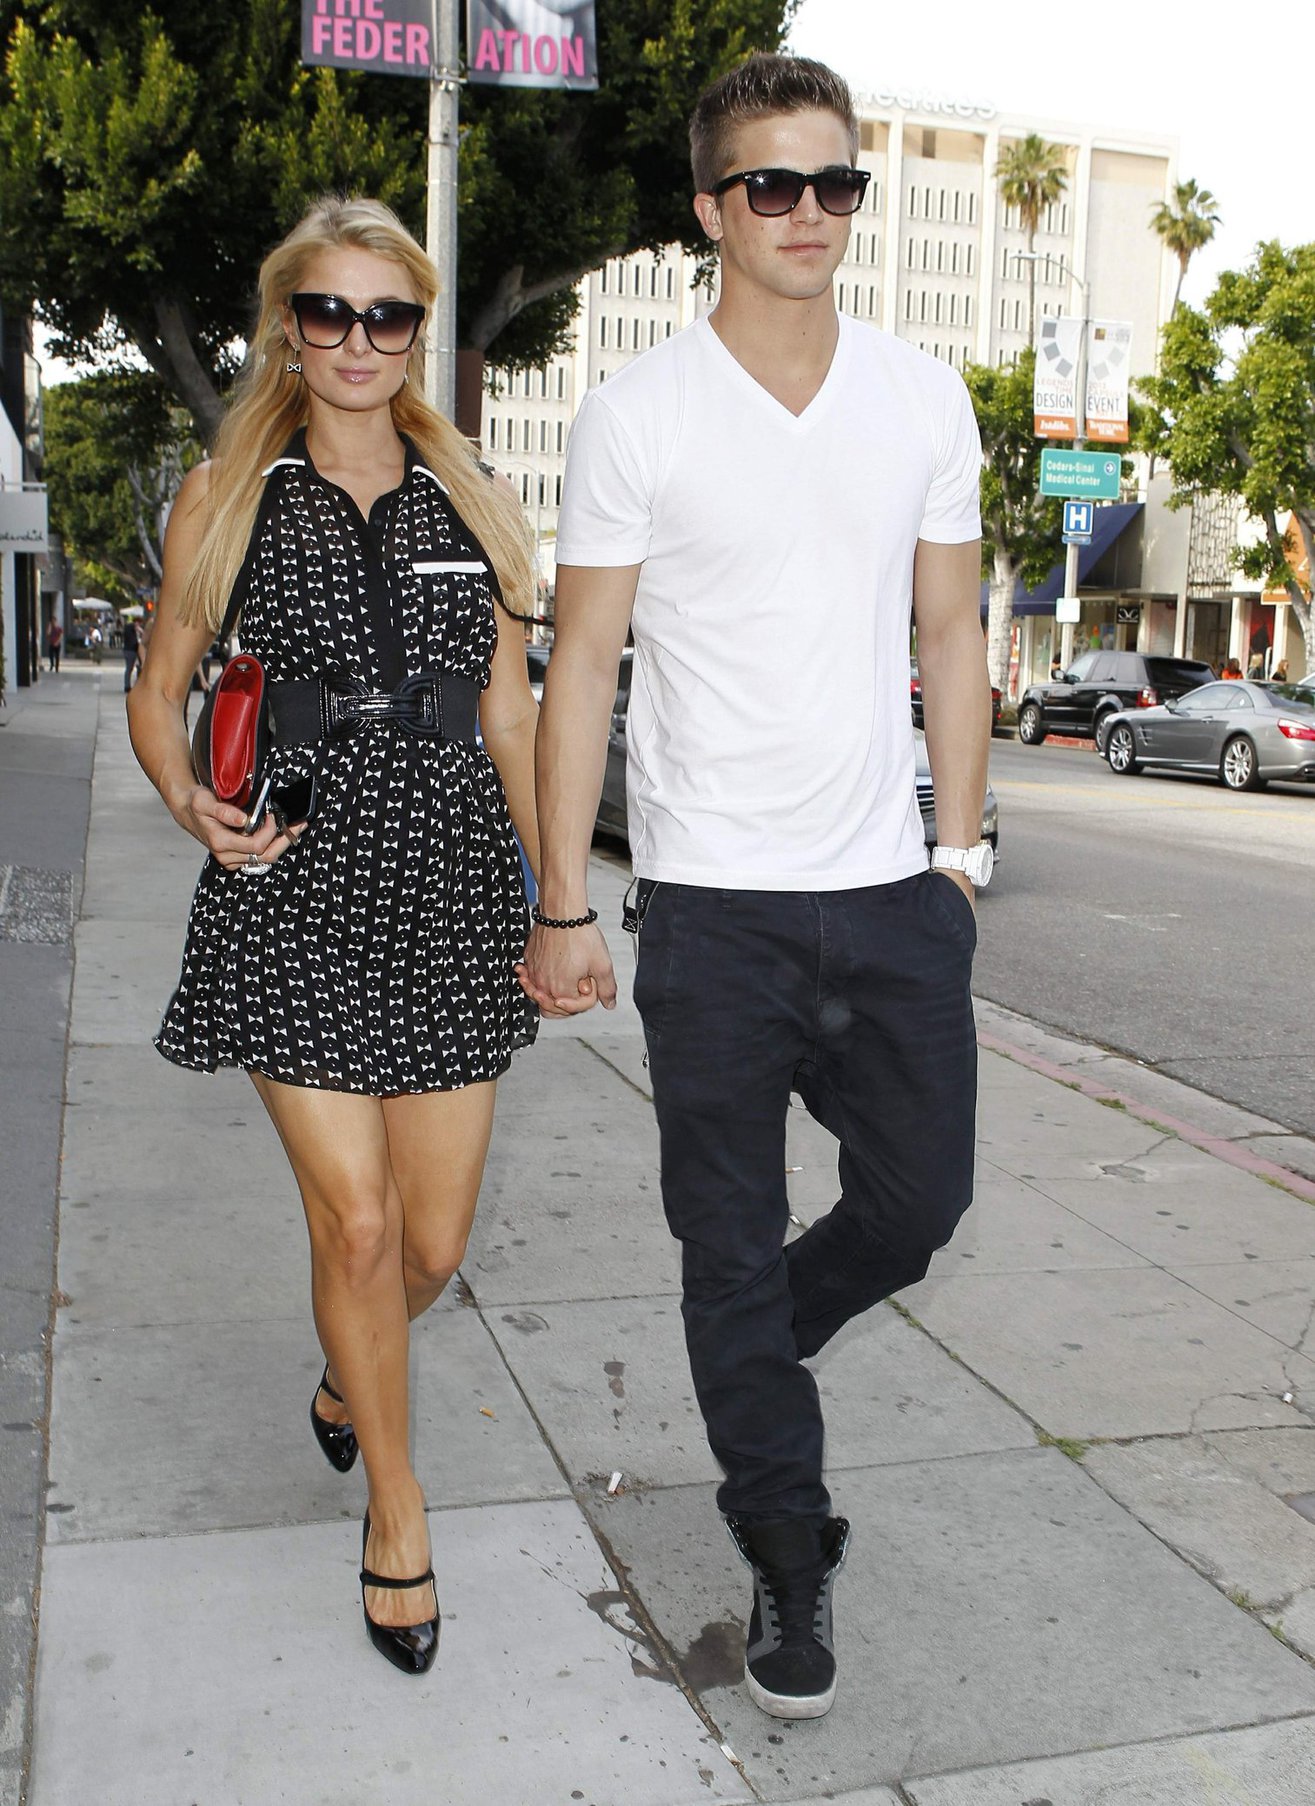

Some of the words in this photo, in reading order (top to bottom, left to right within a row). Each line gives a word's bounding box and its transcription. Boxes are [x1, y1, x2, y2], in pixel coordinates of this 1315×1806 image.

[312, 14, 430, 66] FEDER
[474, 25, 585, 78] ATION
[1036, 392, 1073, 409] DESIGN
[1087, 396, 1120, 412] EVENT
[1046, 460, 1095, 473] Cedars-Sinai
[1045, 472, 1075, 485] Medical
[1075, 475, 1101, 486] Center
[1069, 505, 1088, 530] H
